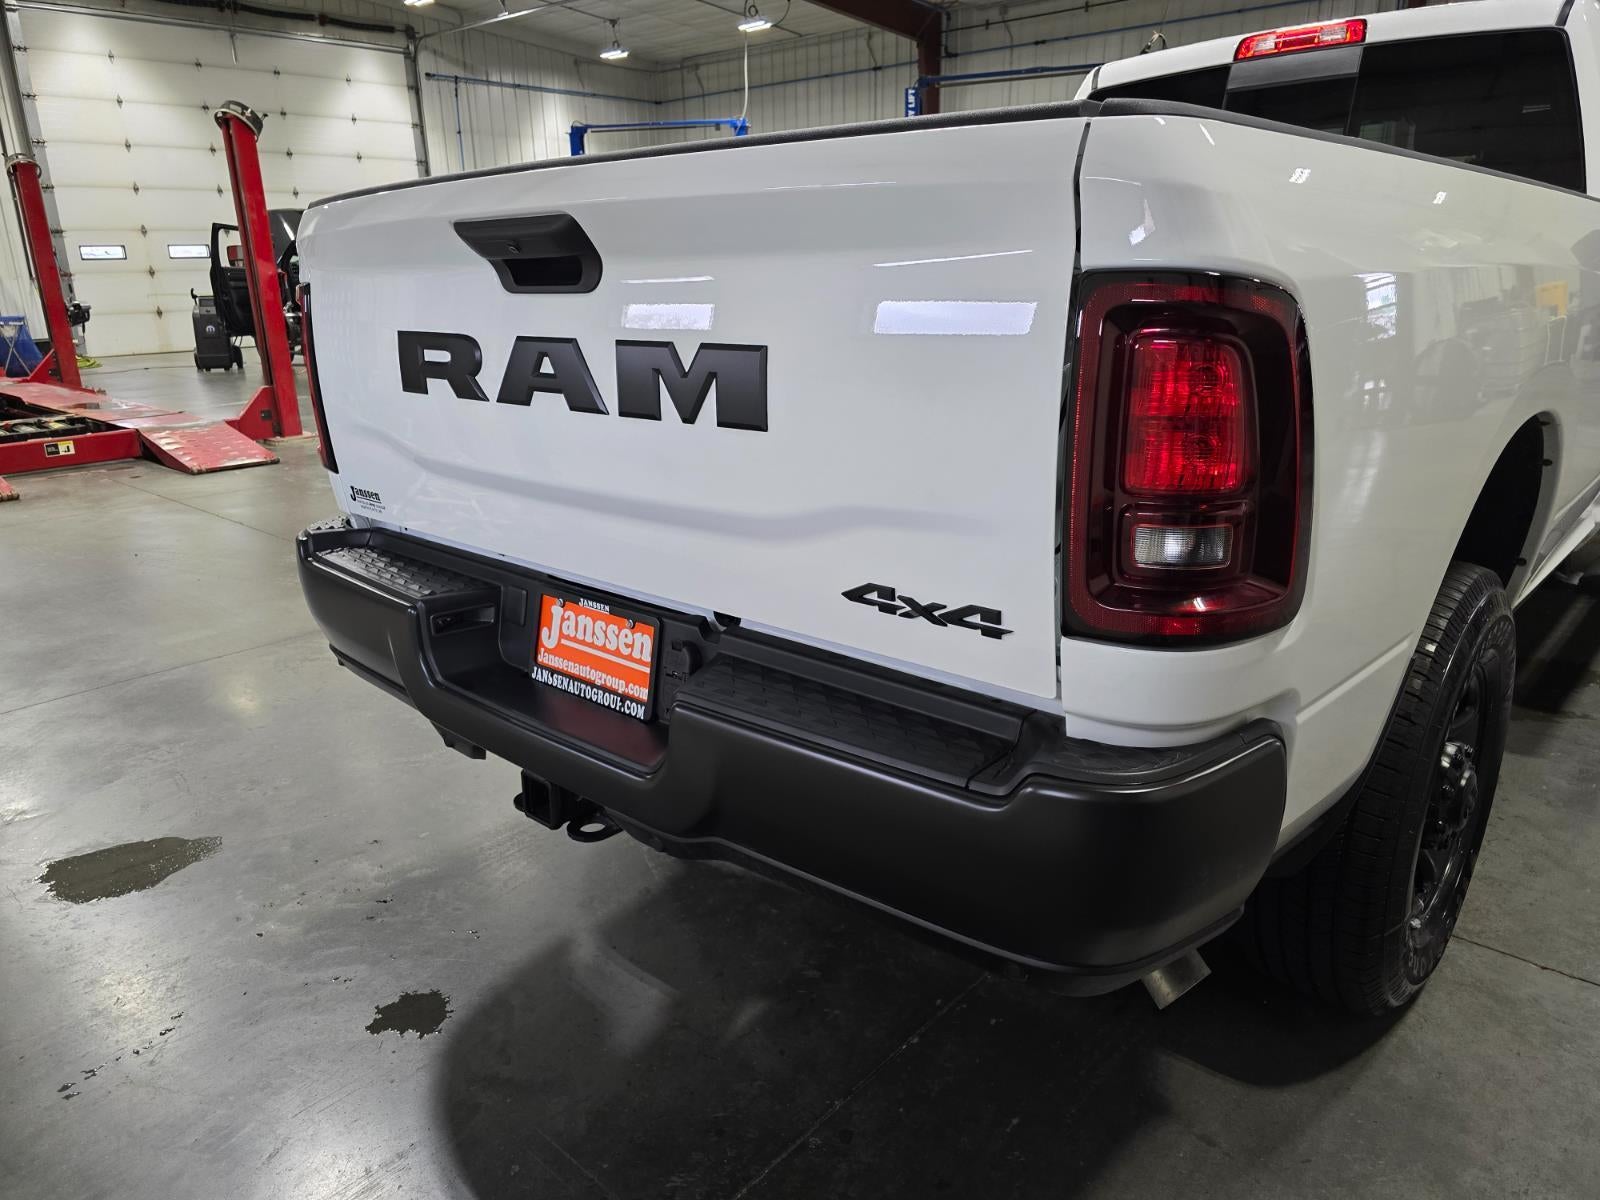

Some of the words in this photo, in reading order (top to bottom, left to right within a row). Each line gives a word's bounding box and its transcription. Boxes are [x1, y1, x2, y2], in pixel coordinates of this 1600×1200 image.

[397, 330, 768, 432] RAM
[350, 486, 381, 501] Janssen
[579, 598, 610, 613] JANSSEN
[541, 605, 652, 662] Janssen
